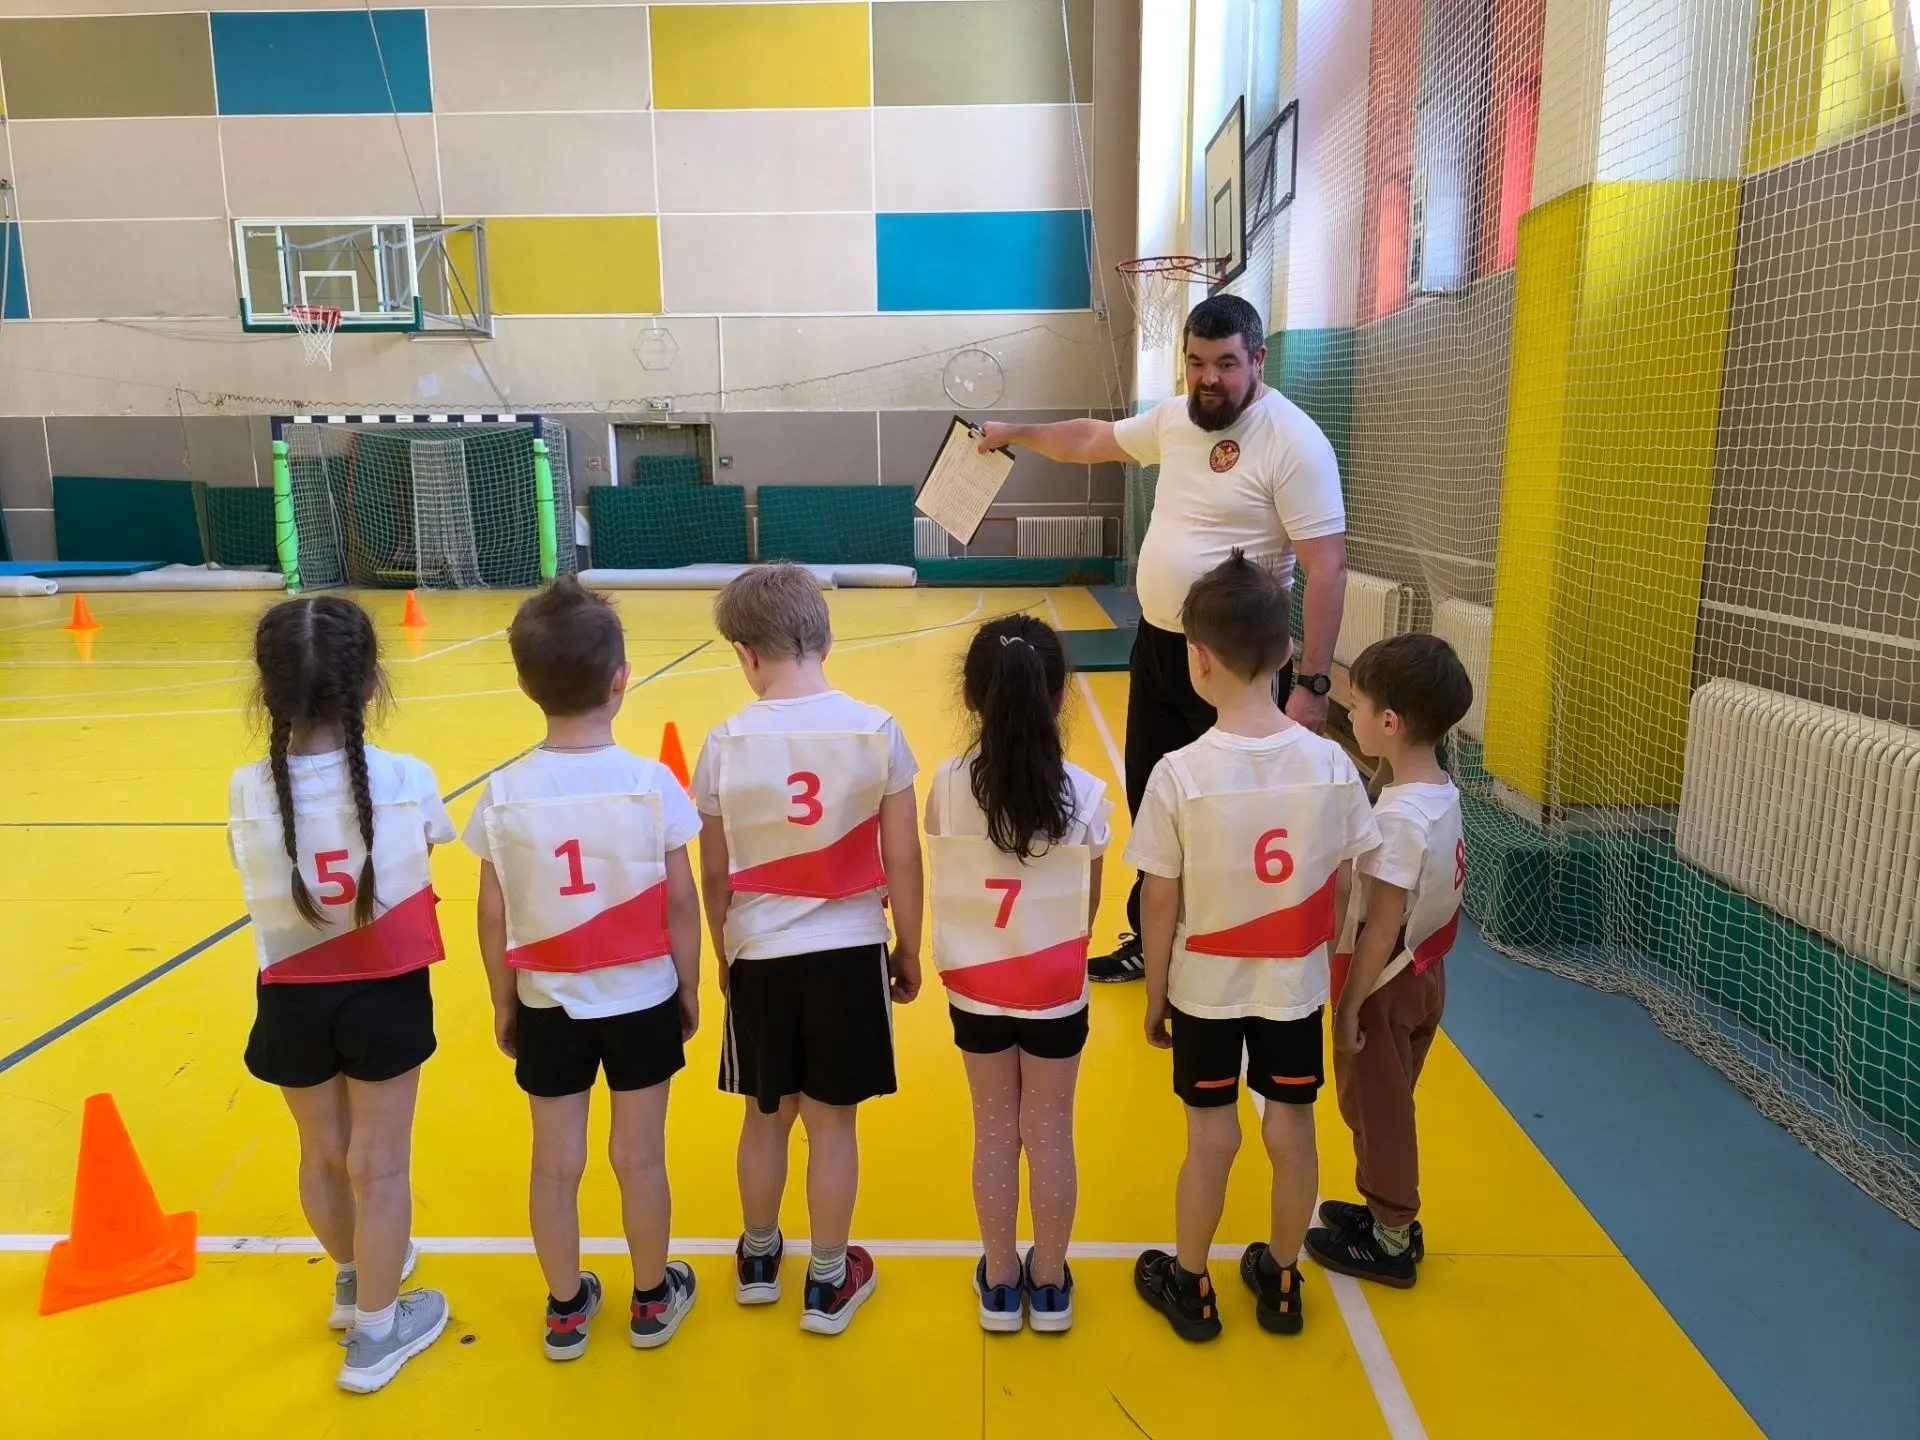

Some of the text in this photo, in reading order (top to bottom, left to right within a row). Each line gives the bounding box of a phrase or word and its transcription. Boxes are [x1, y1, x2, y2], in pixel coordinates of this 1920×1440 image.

[787, 771, 824, 826] 3
[314, 849, 357, 905] 5
[554, 838, 596, 897] 1
[1253, 828, 1293, 884] 6
[984, 877, 1022, 930] 7
